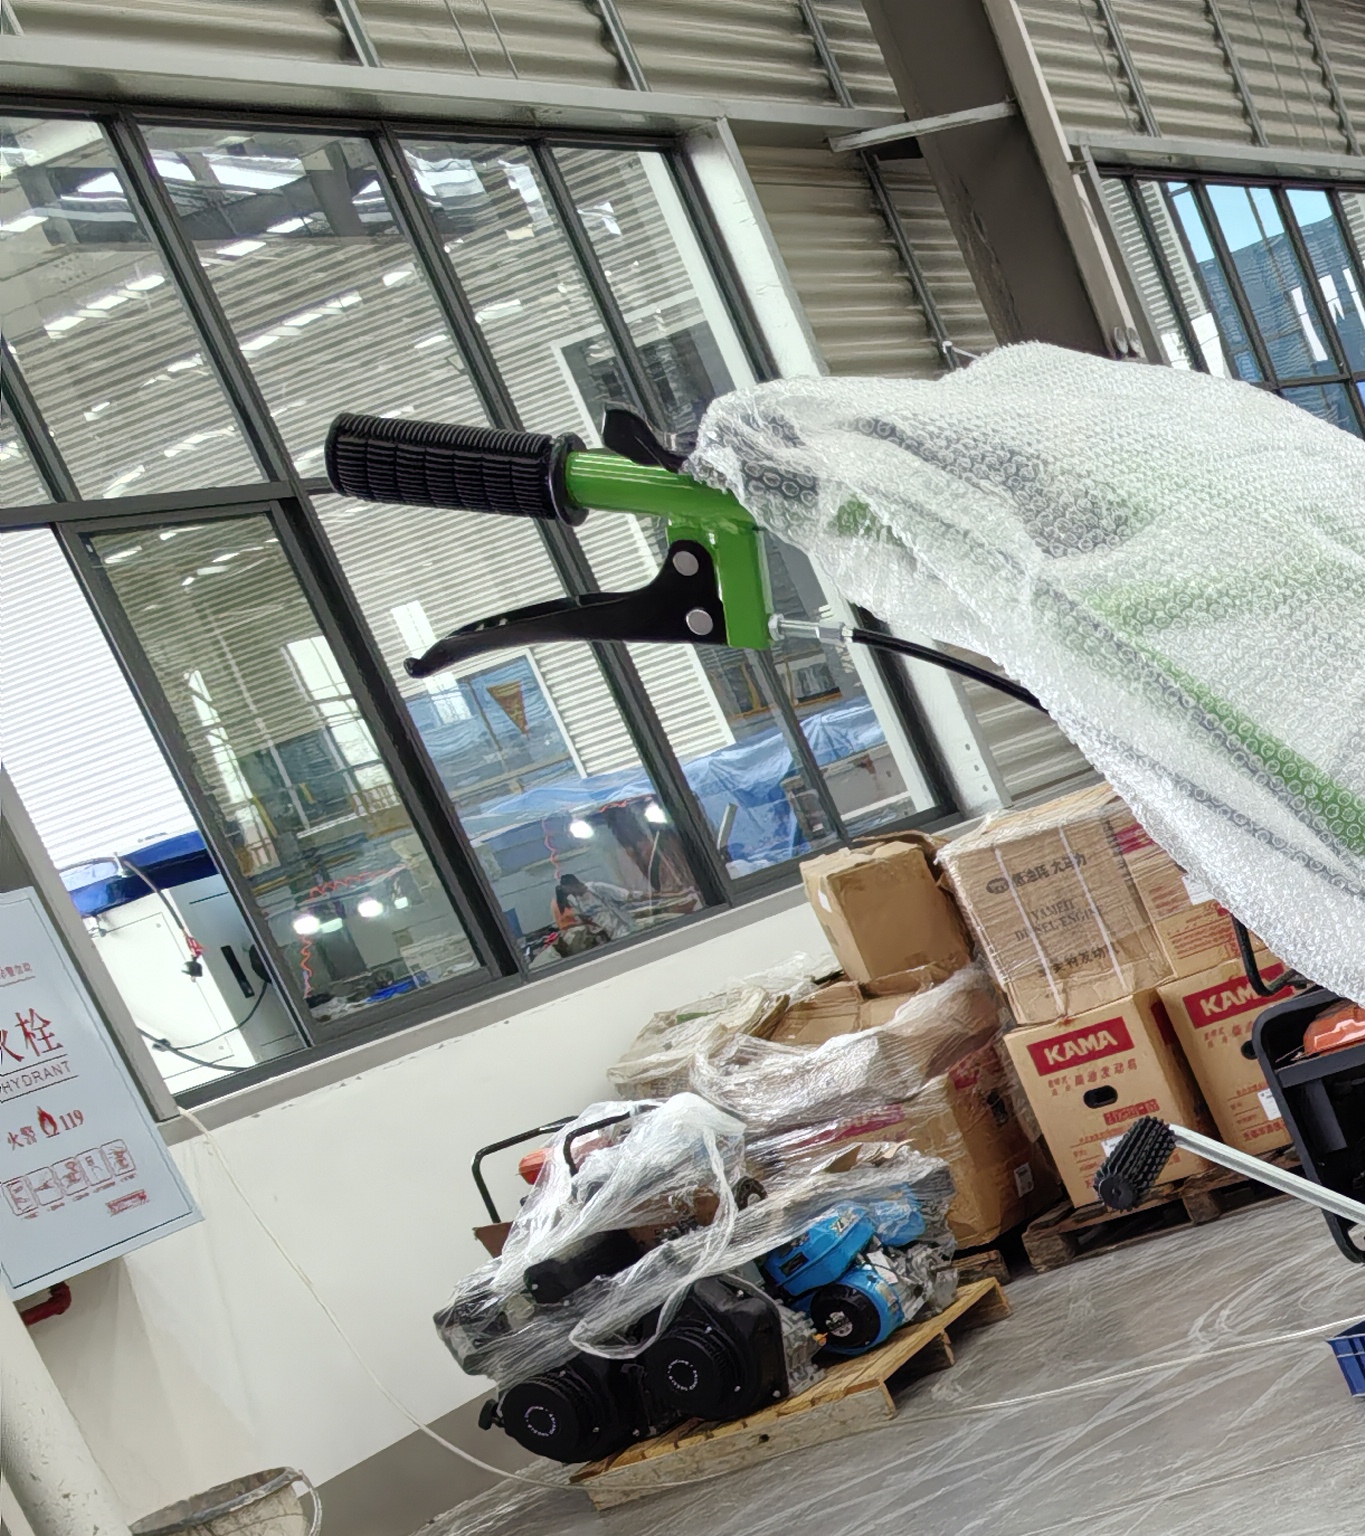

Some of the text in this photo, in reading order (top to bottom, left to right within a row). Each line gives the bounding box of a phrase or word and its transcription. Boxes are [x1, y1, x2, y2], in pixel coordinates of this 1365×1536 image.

[1199, 984, 1260, 1018] KAM
[1043, 1030, 1119, 1066] KAMA
[0, 1060, 72, 1094] HYDRANT
[59, 1109, 85, 1131] 119
